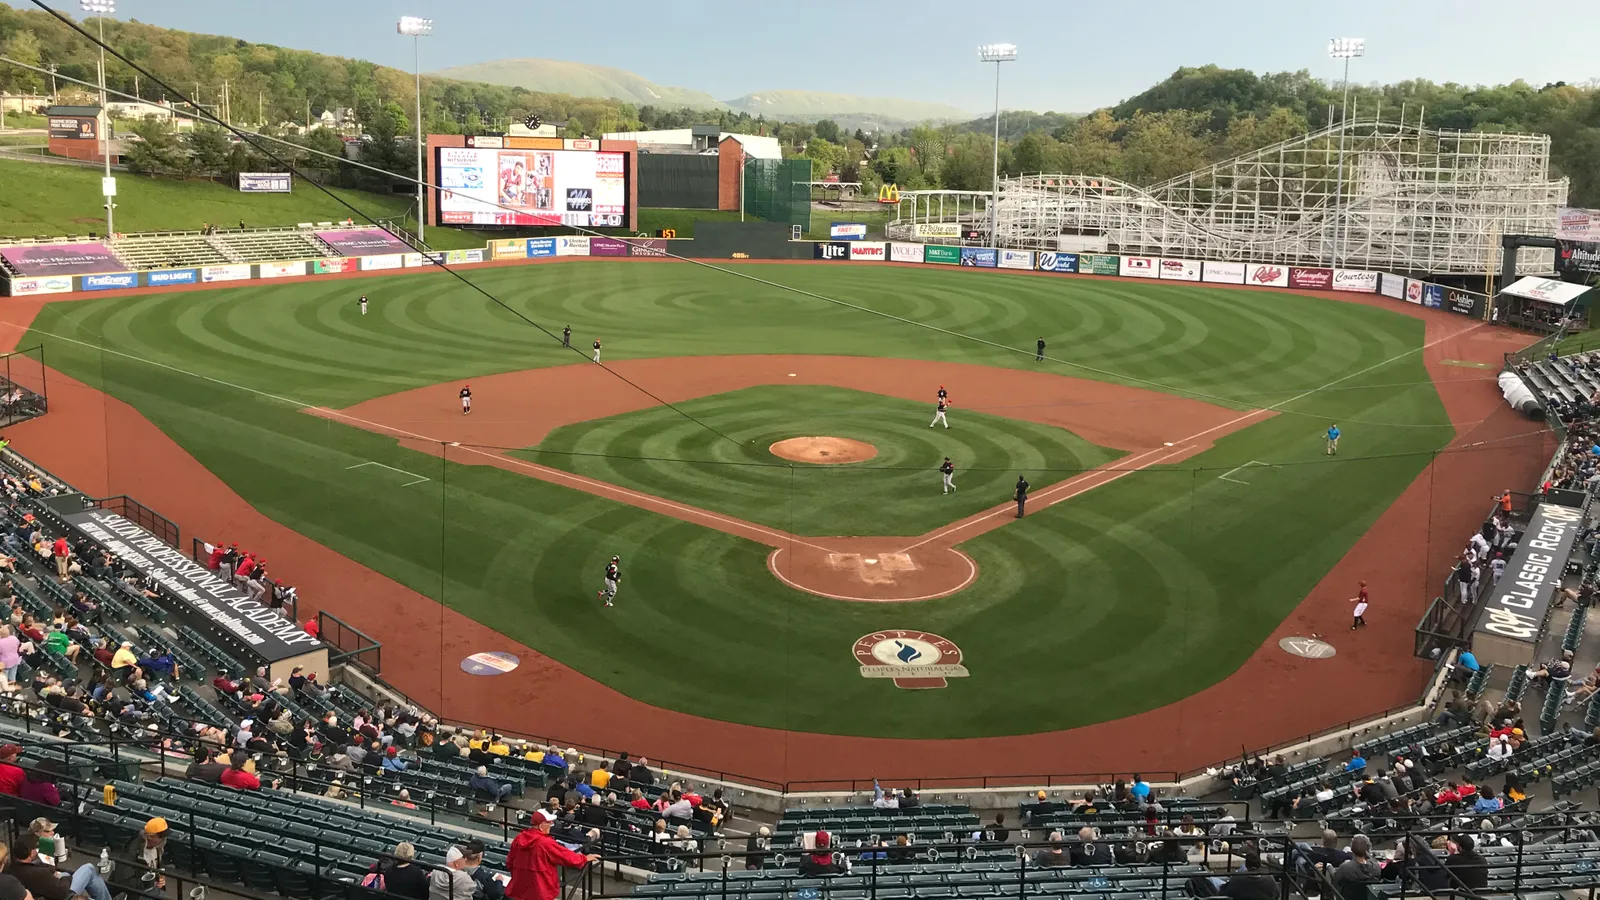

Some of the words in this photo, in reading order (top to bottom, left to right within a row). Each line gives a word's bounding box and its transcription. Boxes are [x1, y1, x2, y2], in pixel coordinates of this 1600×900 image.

[821, 243, 845, 259] Lite
[851, 247, 883, 255] MARTIN'S
[16, 257, 50, 265] UPMC
[170, 272, 193, 281] LIGHT
[1293, 268, 1331, 281] Yuengling
[1335, 270, 1377, 283] Courtesy
[1456, 294, 1475, 308] Ashley
[100, 513, 148, 540] SALON
[130, 533, 238, 598] PROFESSIONAL
[1500, 555, 1553, 609] CLASSIC
[1529, 520, 1567, 551] ROCK
[856, 631, 958, 656] PEOPLES
[862, 665, 901, 674] PEOPLES
[901, 665, 942, 673] NATURAL
